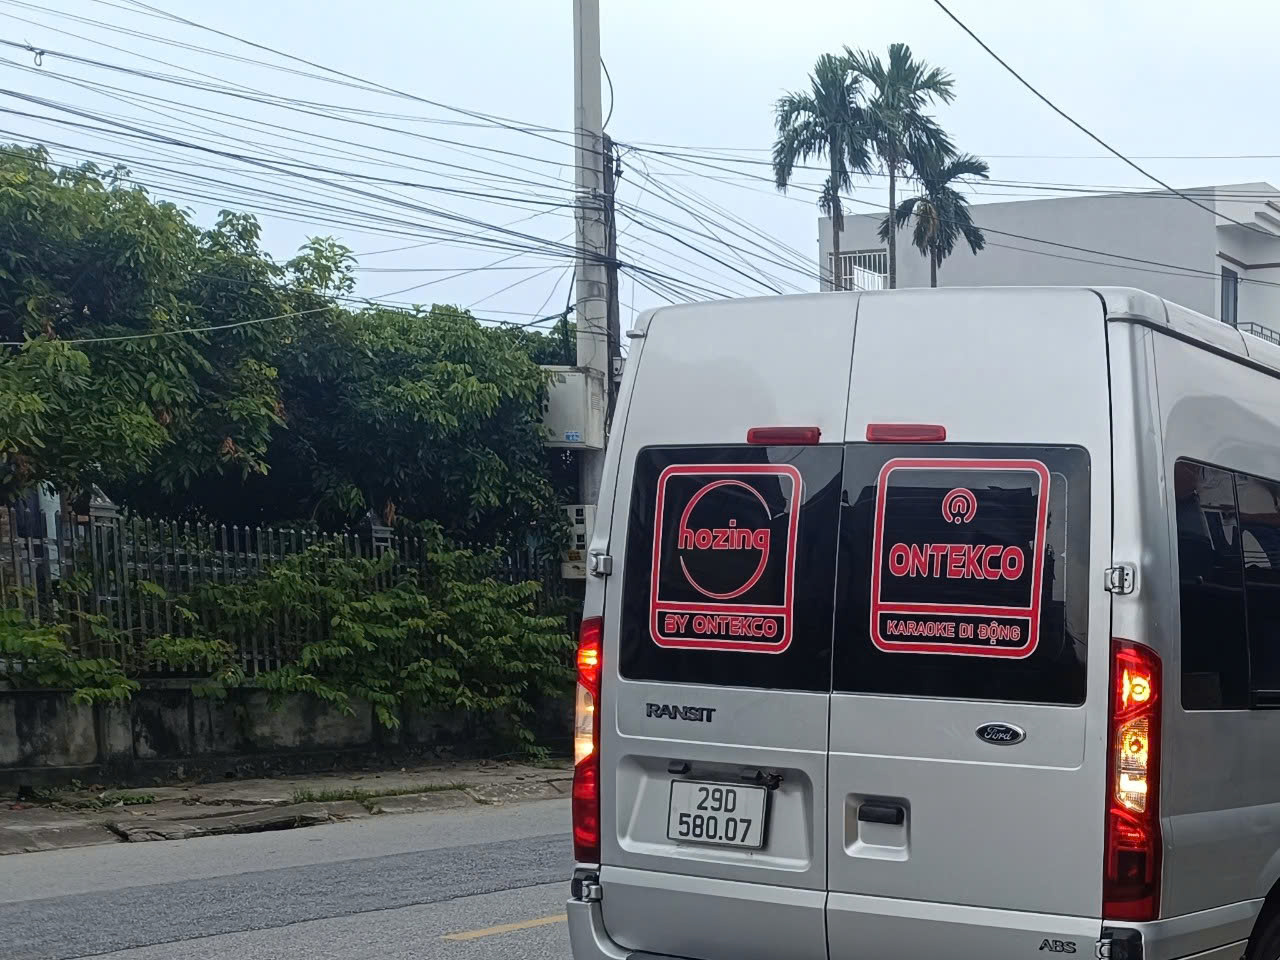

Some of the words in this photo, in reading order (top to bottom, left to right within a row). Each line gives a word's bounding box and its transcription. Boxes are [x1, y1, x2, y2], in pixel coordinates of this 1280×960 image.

[678, 519, 770, 550] hozing
[889, 543, 1025, 581] ONTEKCO
[664, 615, 689, 633] BY
[693, 615, 777, 638] ONTEKCO
[887, 620, 955, 639] KARAOKE
[959, 622, 974, 639] DI
[977, 621, 1021, 645] ĐỘNG
[645, 703, 716, 723] RANSIT
[984, 725, 1012, 742] Ford
[697, 786, 737, 813] 29D
[677, 812, 752, 843] 580.07
[1038, 938, 1076, 954] ABS
